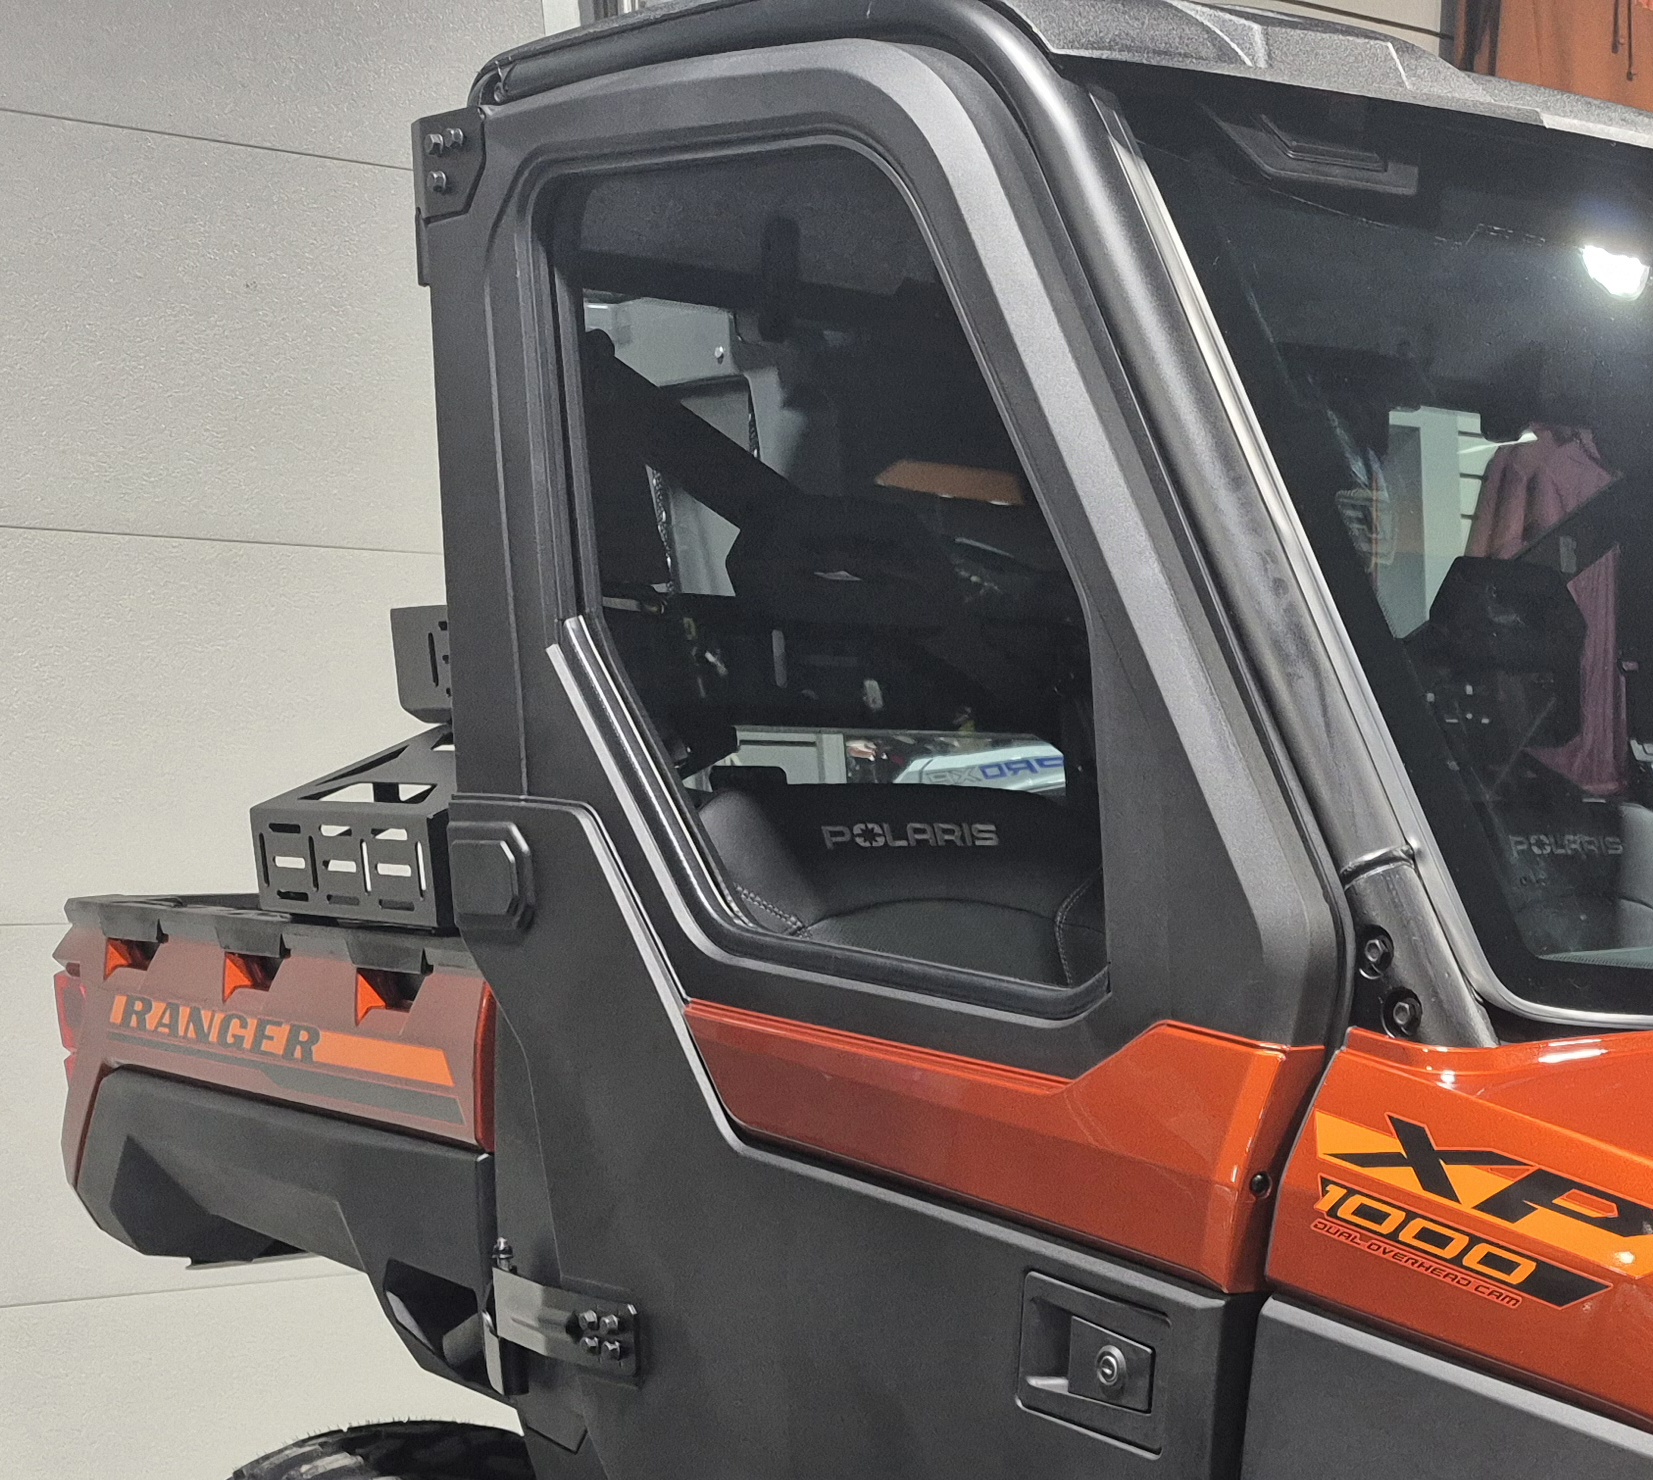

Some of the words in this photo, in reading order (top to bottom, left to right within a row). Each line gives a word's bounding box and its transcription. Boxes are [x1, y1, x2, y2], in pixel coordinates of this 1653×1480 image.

[821, 821, 999, 850] POLARIS
[1507, 833, 1624, 858] POLARIS
[121, 993, 322, 1066] RANGER
[1312, 1220, 1364, 1246] DUAL
[1365, 1238, 1473, 1288] OVERHEAD
[1473, 1283, 1523, 1308] CAM
[1313, 1184, 1537, 1285] 1000
